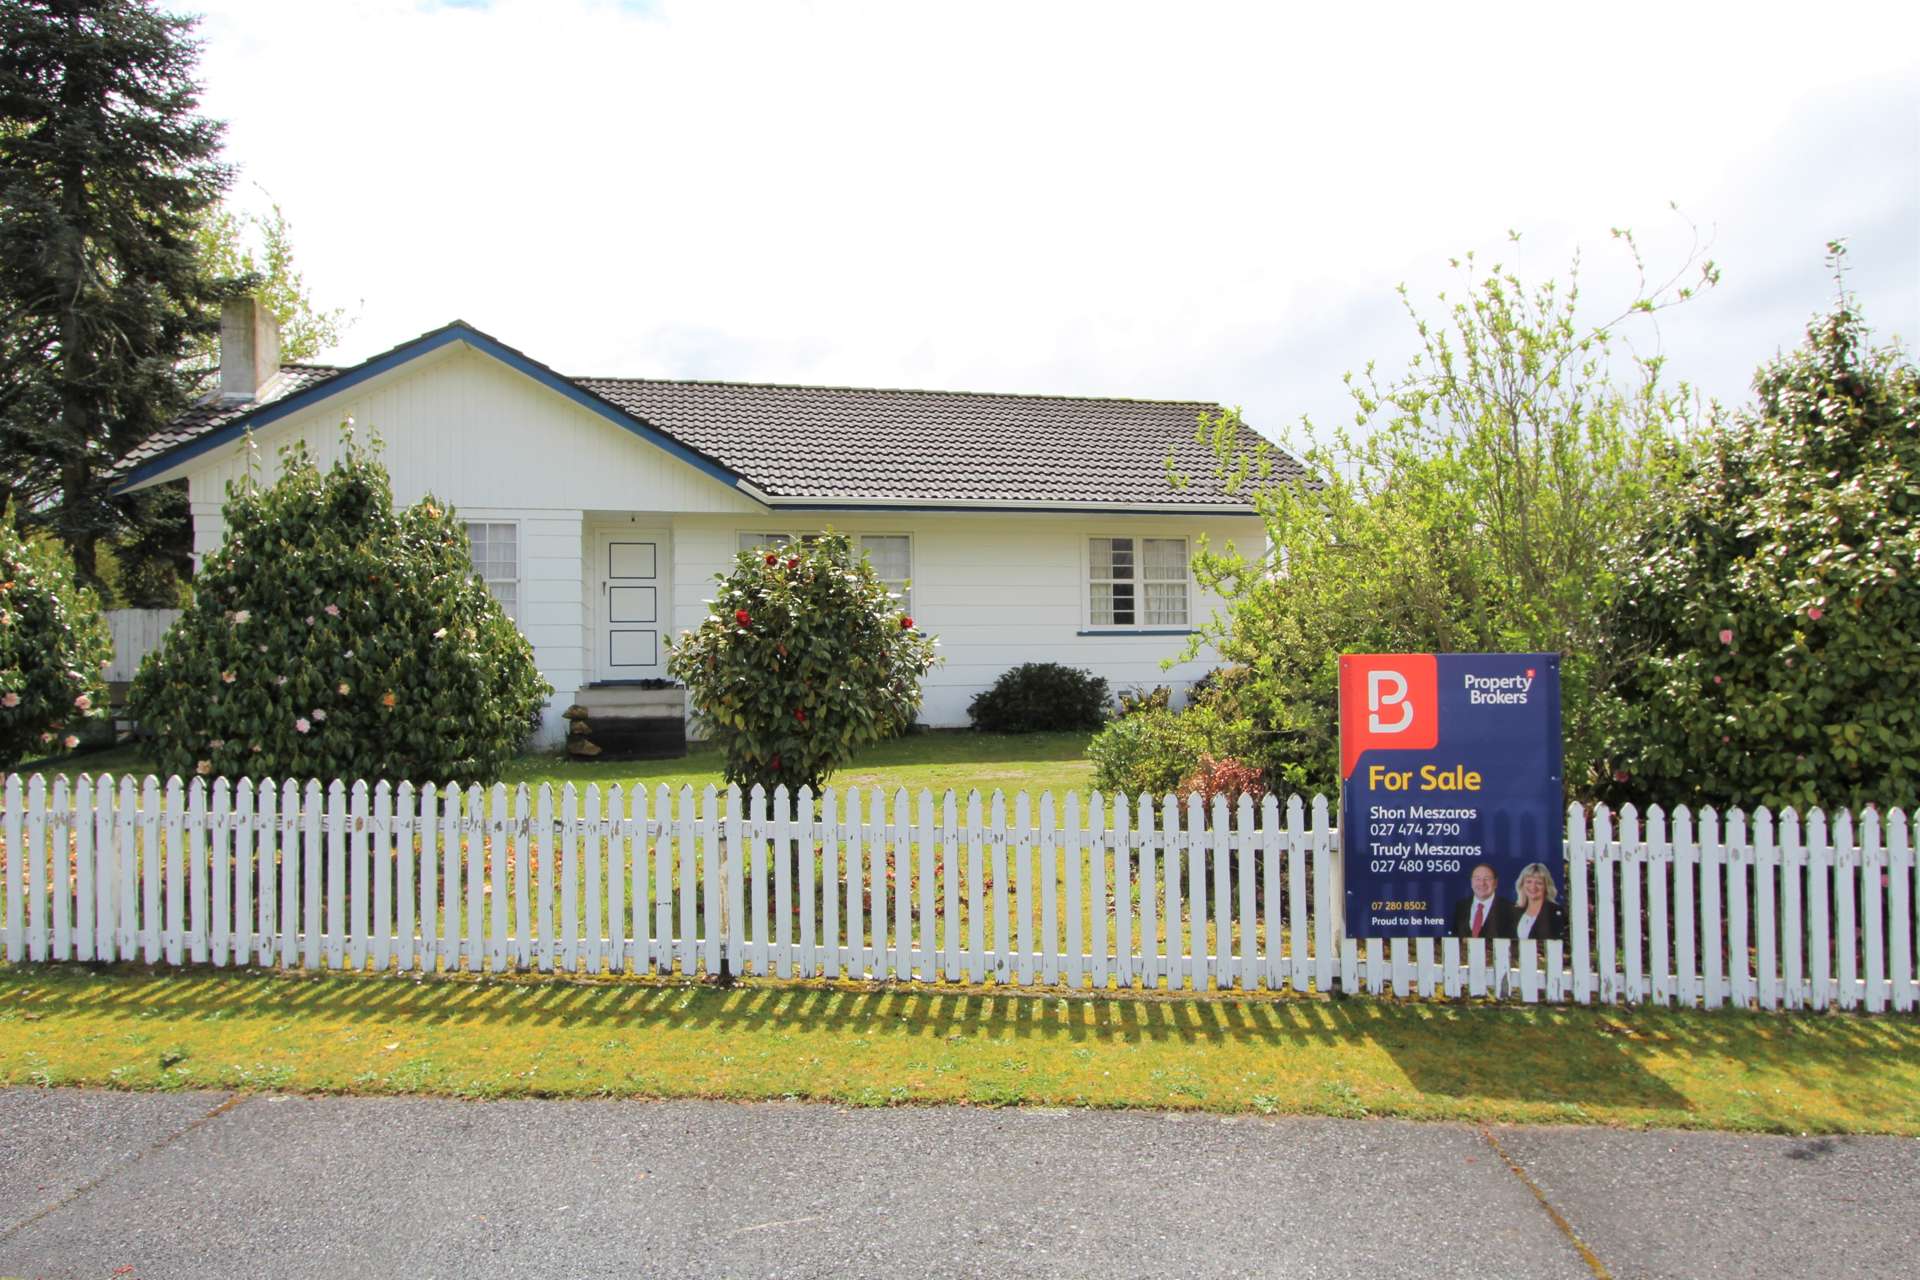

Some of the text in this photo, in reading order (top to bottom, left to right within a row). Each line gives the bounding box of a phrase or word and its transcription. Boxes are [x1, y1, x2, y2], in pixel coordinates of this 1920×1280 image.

[1465, 674, 1532, 692] Property
[1470, 689, 1528, 704] Brokers
[1369, 764, 1482, 791] For Sale
[1370, 806, 1477, 820] Shon Meszaros
[1370, 823, 1460, 836] 027 474 2790
[1370, 842, 1482, 859] Trudy Meszaros
[1370, 860, 1460, 872] 027 480 9560
[1371, 901, 1382, 911] 07
[1371, 916, 1444, 926] Proud to be here
